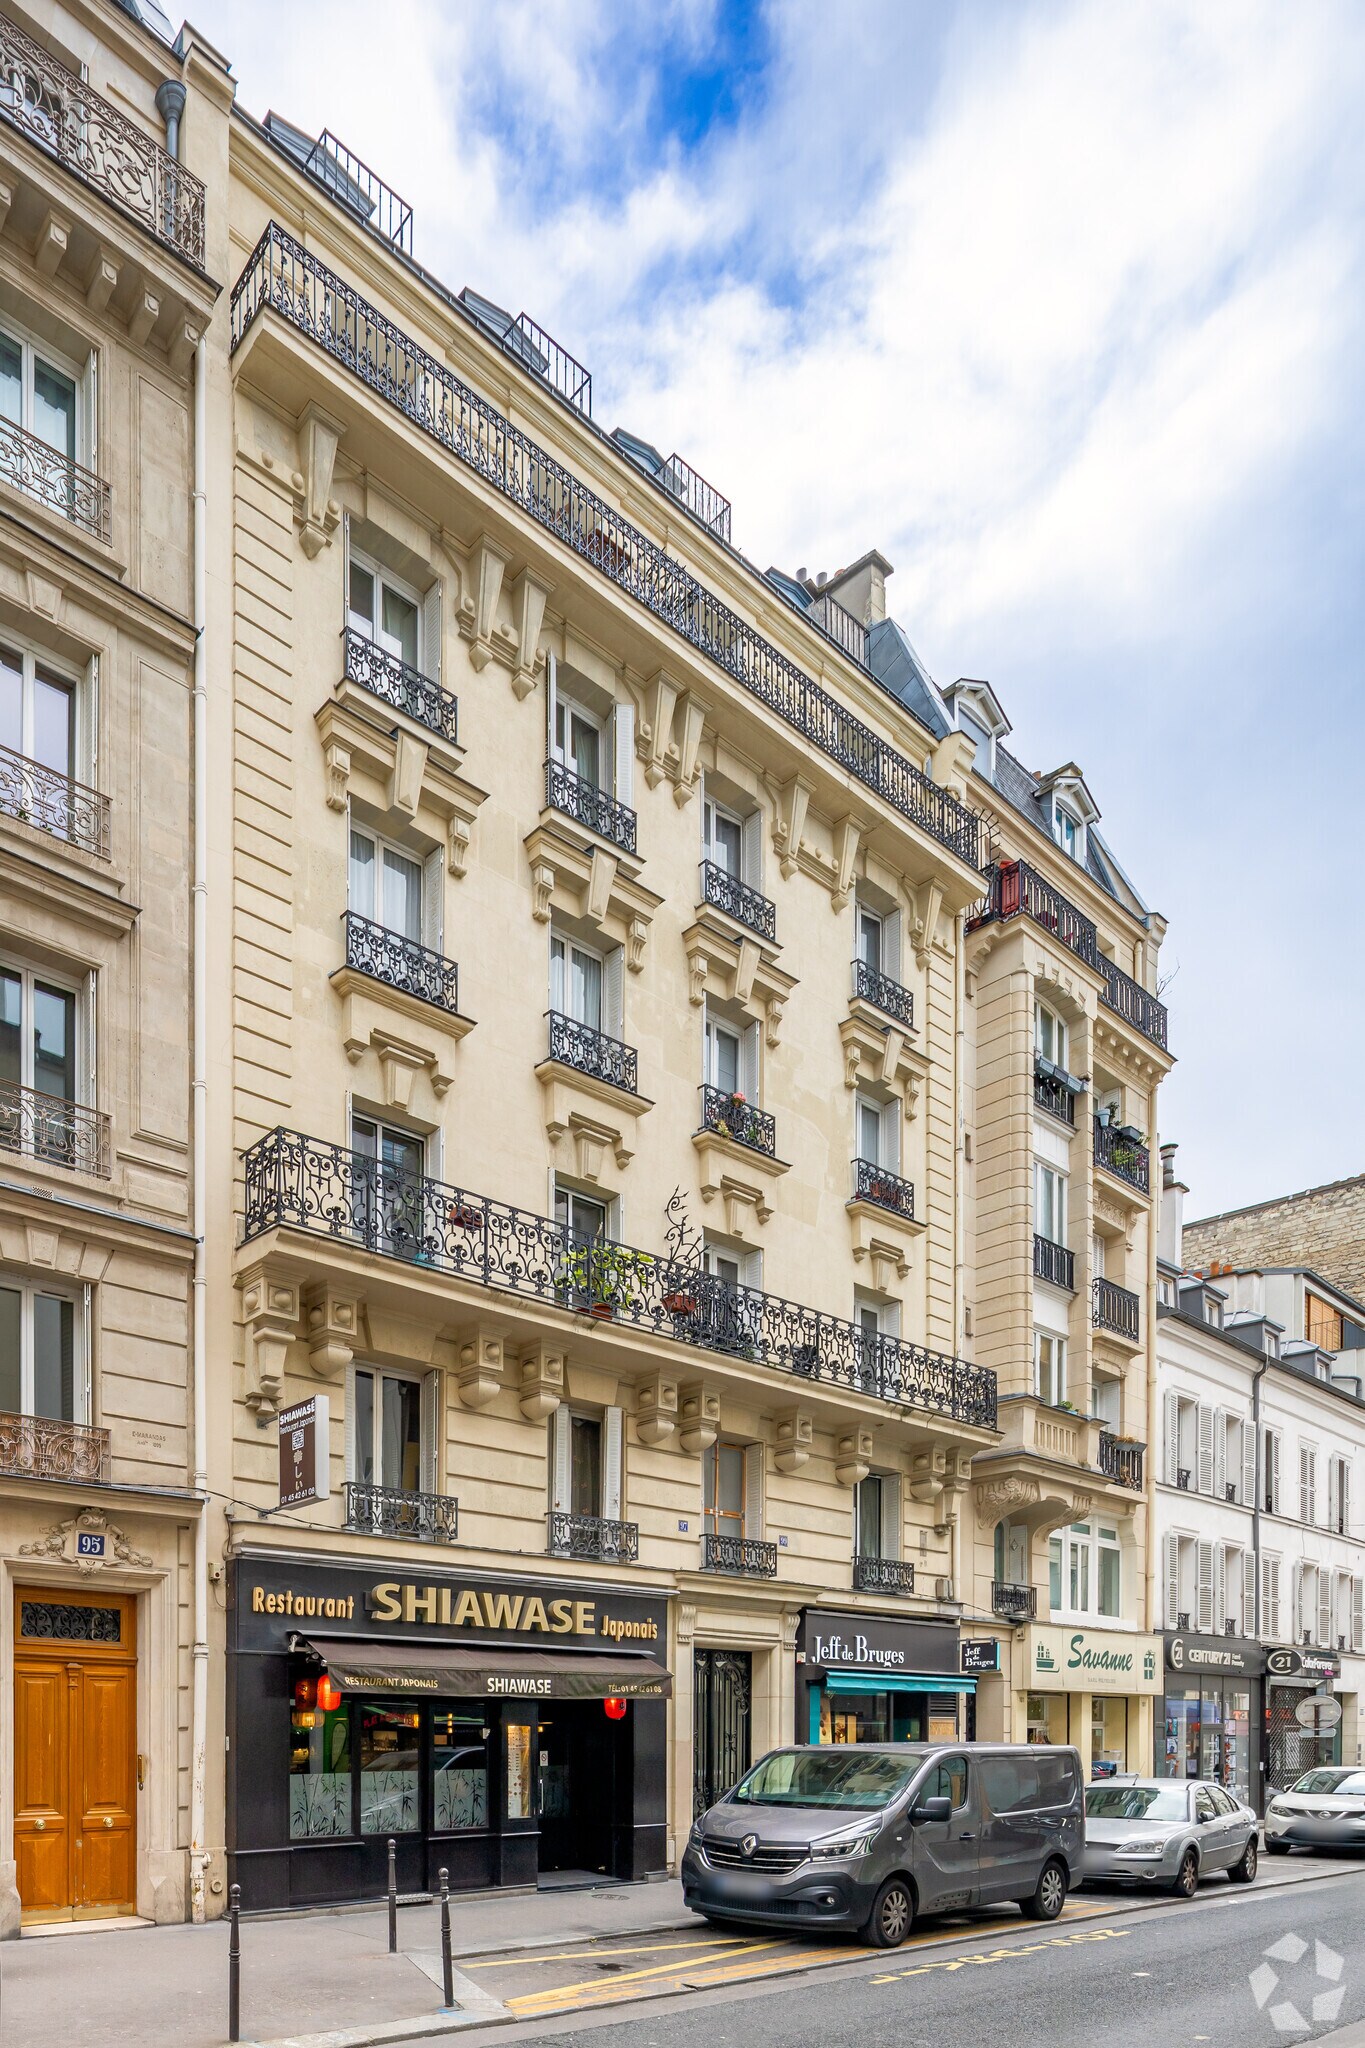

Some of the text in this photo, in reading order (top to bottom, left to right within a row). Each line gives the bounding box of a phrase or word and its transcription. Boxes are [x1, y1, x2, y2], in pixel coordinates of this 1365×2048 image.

[280, 1400, 315, 1425] SHIAWASÉ
[295, 1491, 301, 1499] 42
[82, 1536, 101, 1553] 95
[252, 1583, 657, 1642] Restaurant SHIAWASE Japonais
[811, 1635, 905, 1667] Jeff de Bruges
[965, 1647, 980, 1656] Jeff
[1067, 1634, 1133, 1671] Savanne
[1188, 1649, 1223, 1664] CENTURY
[1223, 1652, 1231, 1665] 21
[965, 1658, 995, 1667] Bruges
[344, 1677, 438, 1688] RESTAURANT JAPONAIS
[487, 1677, 551, 1693] SHIAWASE
